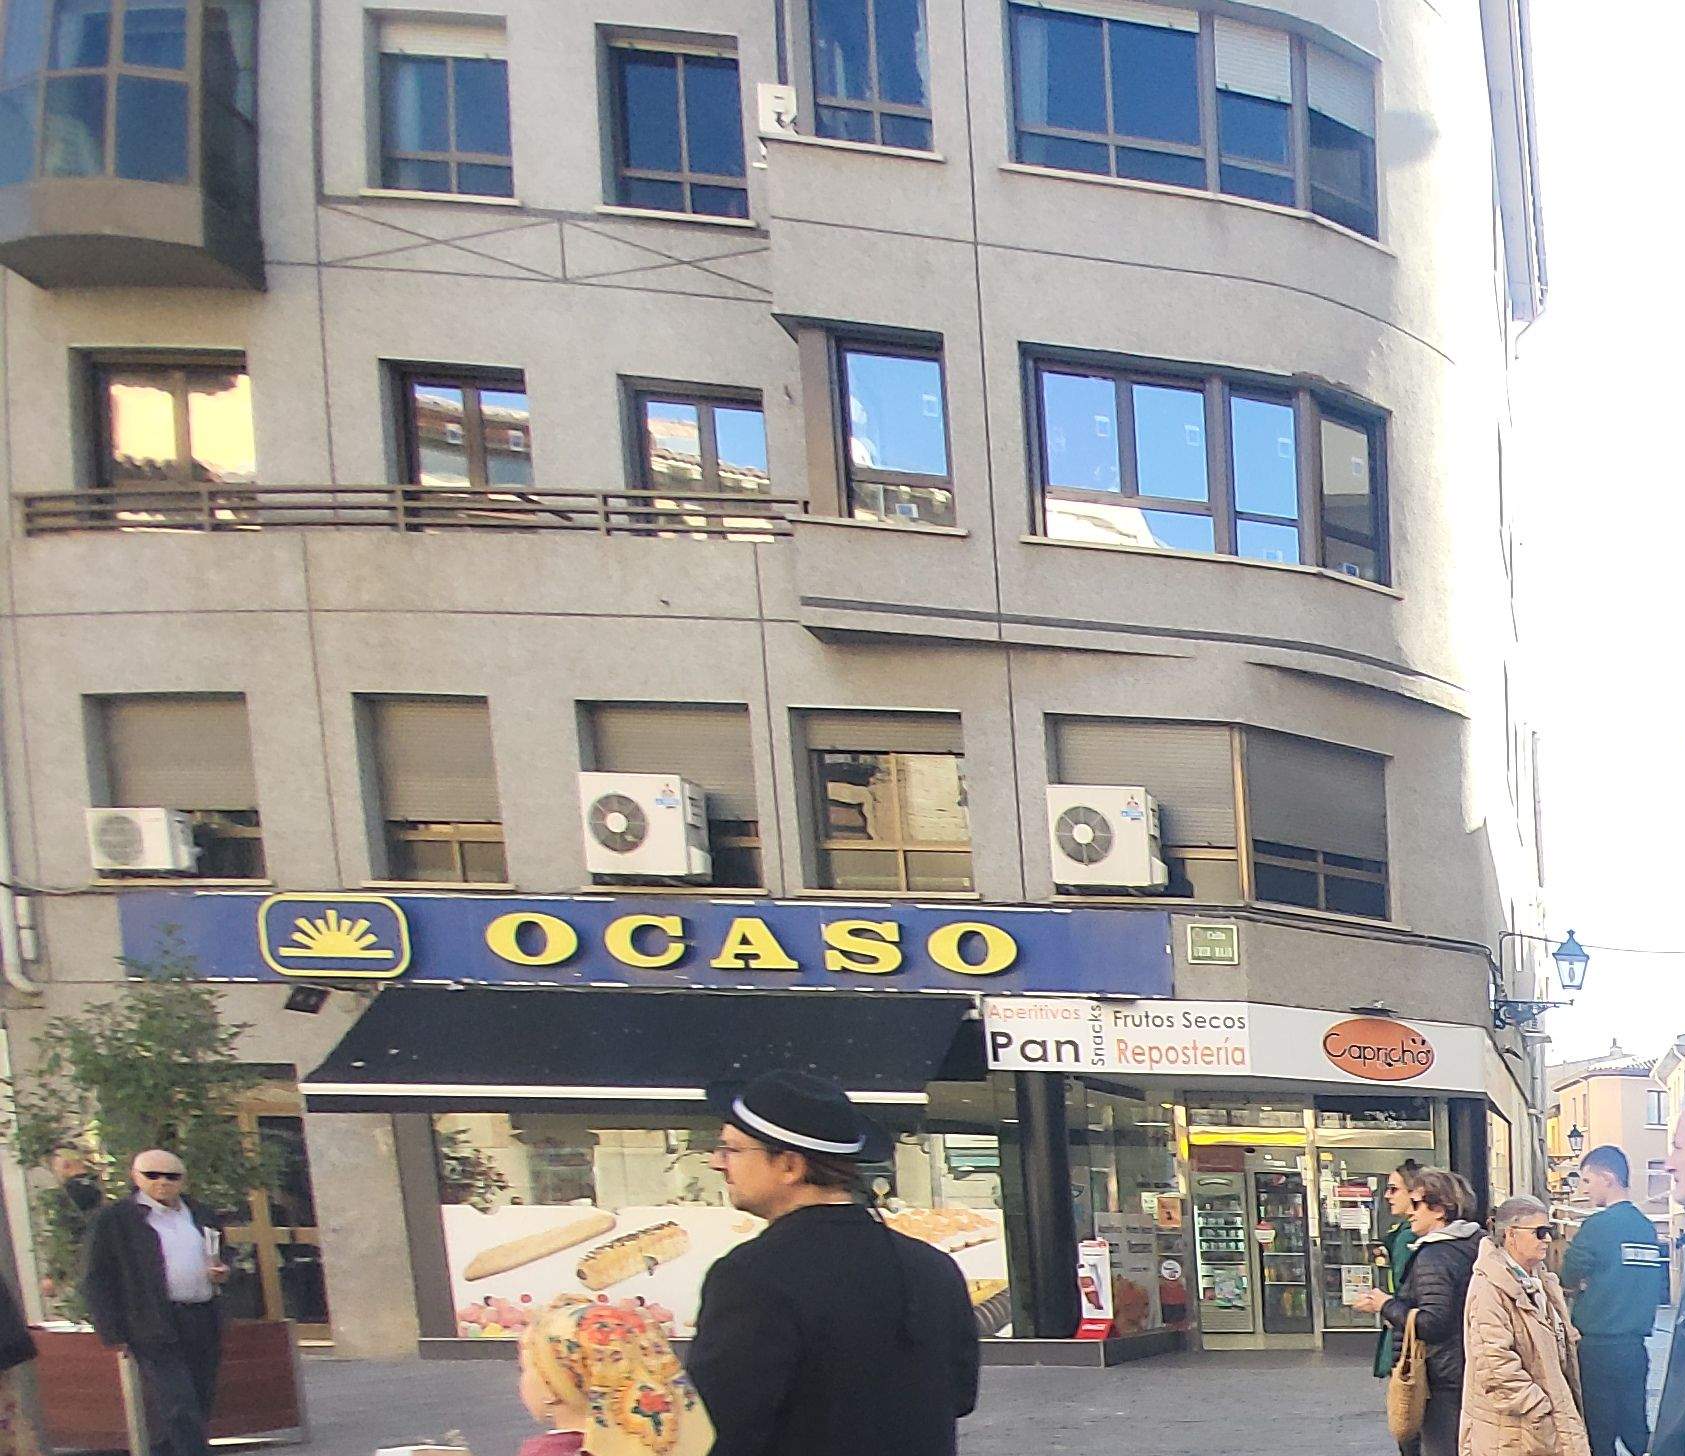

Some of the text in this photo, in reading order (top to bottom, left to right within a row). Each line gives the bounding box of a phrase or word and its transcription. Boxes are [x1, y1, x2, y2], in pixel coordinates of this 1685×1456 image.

[485, 912, 1018, 976] OCASO
[988, 1004, 1081, 1022] Aperitivos
[1113, 1010, 1246, 1029] Frutos Secos
[990, 1031, 1080, 1063] Pan
[1087, 1004, 1105, 1066] Snacks
[1323, 1033, 1431, 1067] Capricho
[1116, 1037, 1246, 1070] Repostería
